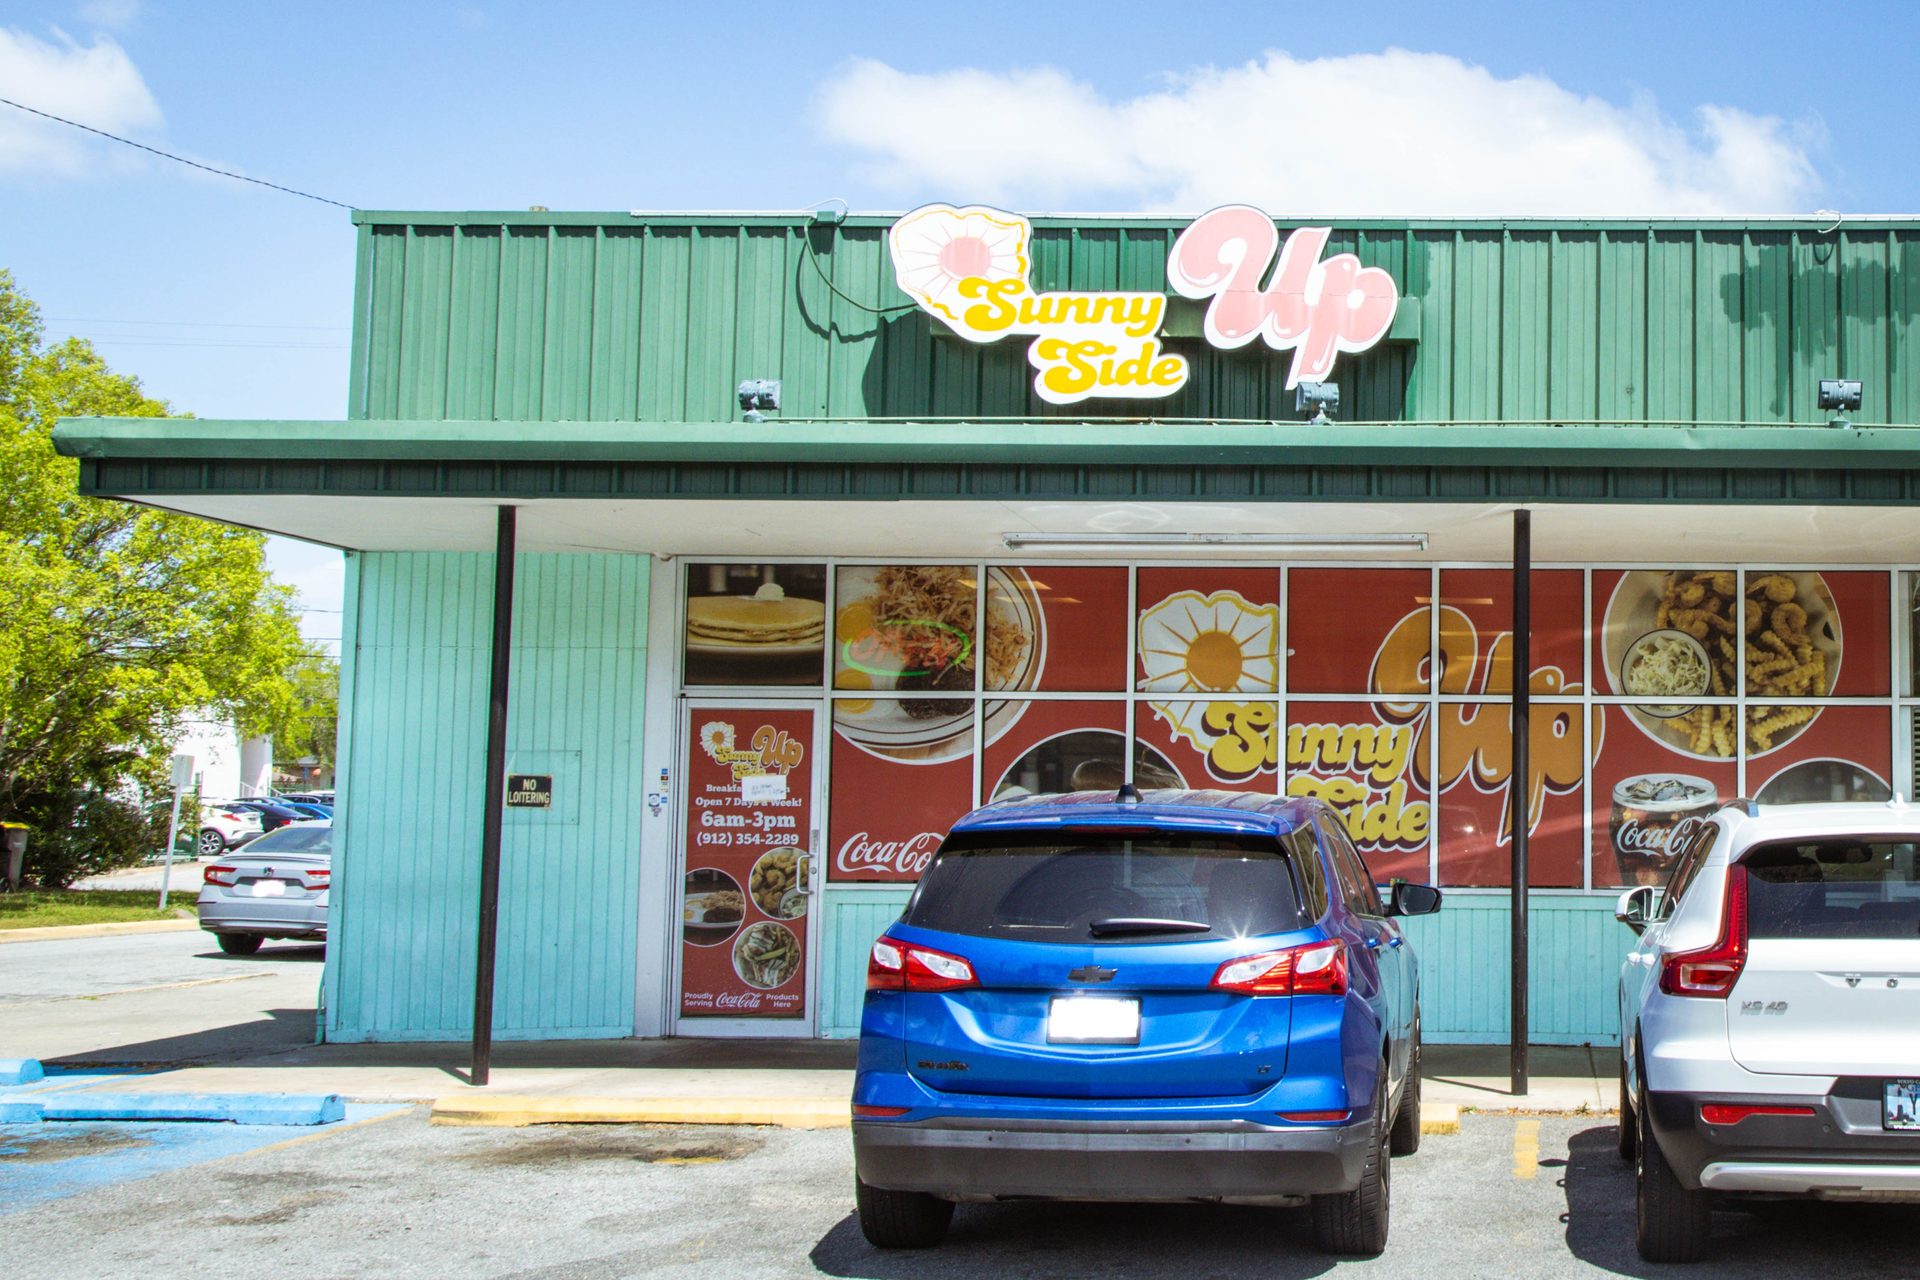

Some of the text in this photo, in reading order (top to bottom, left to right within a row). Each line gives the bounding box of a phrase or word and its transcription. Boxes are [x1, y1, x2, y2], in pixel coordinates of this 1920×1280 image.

[1173, 206, 1397, 381] Up
[958, 277, 1163, 337] Sunny
[1037, 338, 1183, 394] Side
[1368, 605, 1604, 846] Up
[752, 725, 803, 777] Up
[1201, 701, 1412, 788] Sunny
[716, 747, 760, 766] Sunny
[522, 779, 537, 791] NO
[706, 784, 742, 793] Breakfa
[508, 791, 550, 804] LOITERING
[695, 797, 723, 807] Open
[725, 798, 732, 806] 7
[701, 811, 796, 831] 6am-3pm
[697, 832, 732, 846] (912)
[736, 834, 800, 845] 354-2289
[1616, 815, 1704, 857] Coca-C
[837, 831, 944, 872] Coca-Co
[684, 992, 713, 1000] Proudly
[684, 1000, 713, 1008] Serving
[716, 991, 763, 1008] Coca-Cola
[766, 993, 799, 1001] Products
